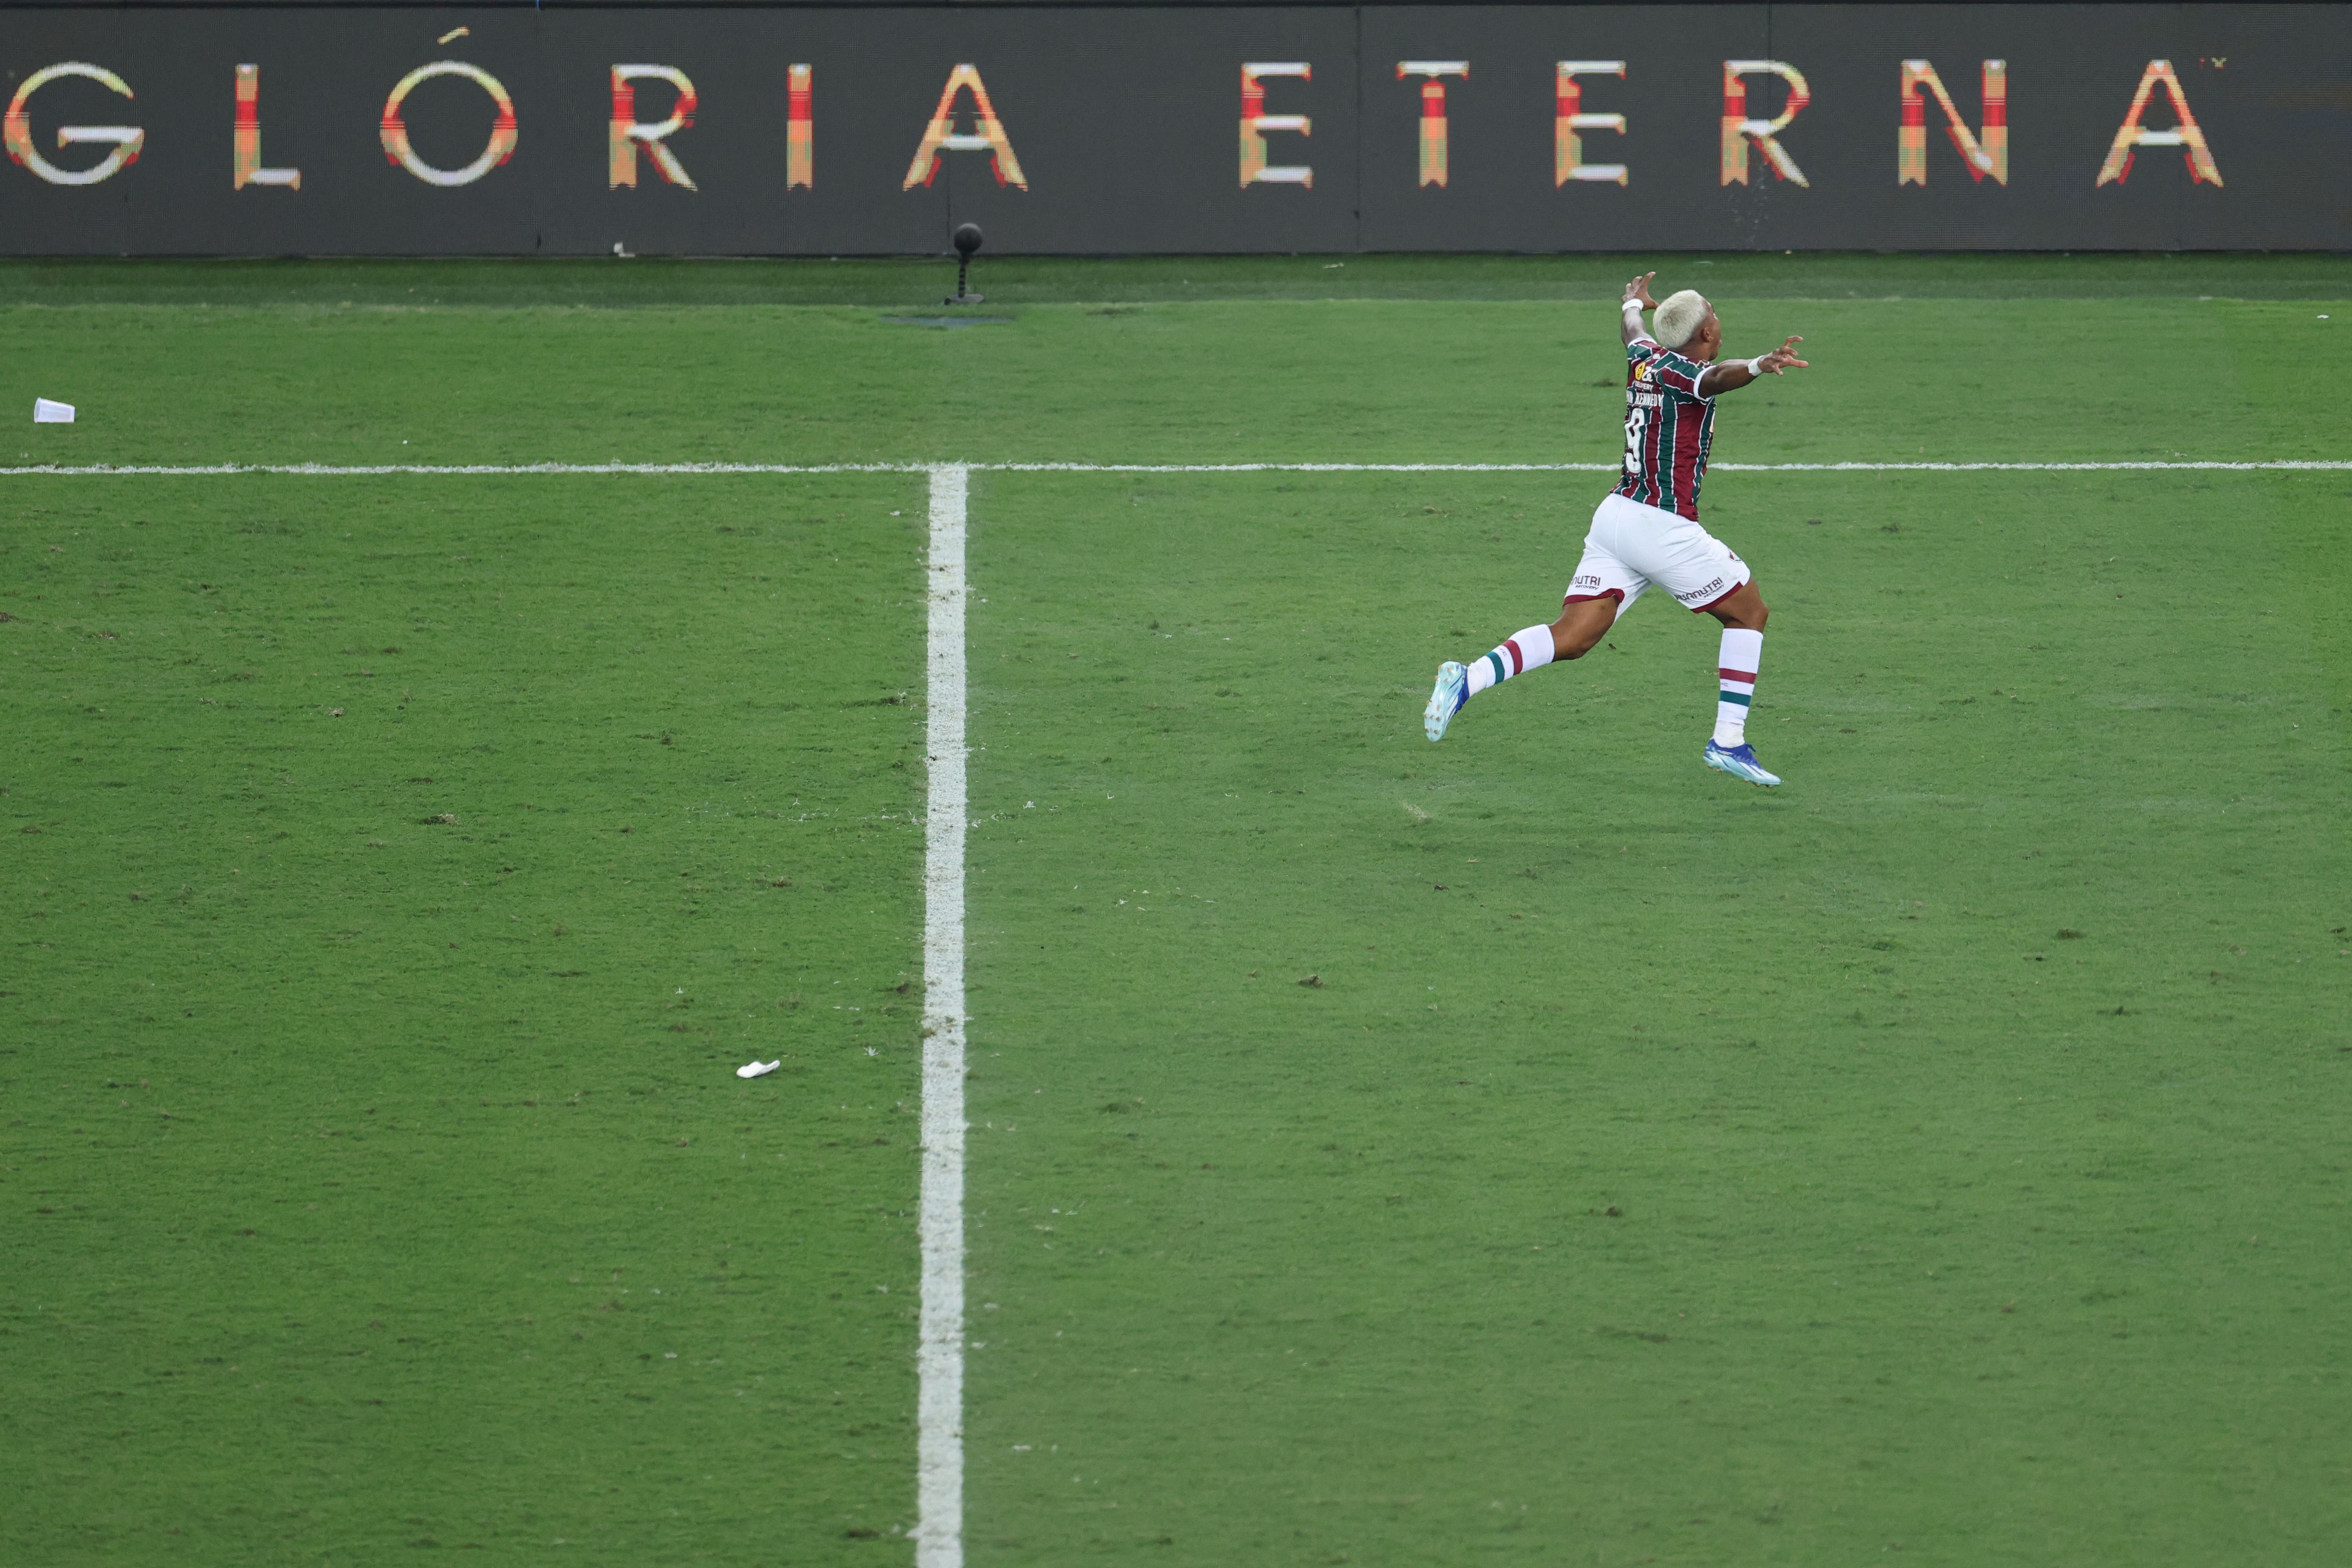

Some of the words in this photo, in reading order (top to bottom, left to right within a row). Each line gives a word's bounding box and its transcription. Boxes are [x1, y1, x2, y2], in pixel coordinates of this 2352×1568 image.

[3, 27, 1029, 192] GLÓRIA
[1239, 59, 2225, 189] ETERNA
[1635, 380, 1654, 390] DELIVERY
[1634, 392, 1664, 407] KENNEDY
[1624, 408, 1645, 473] 9
[1571, 575, 1601, 586] NUTRI
